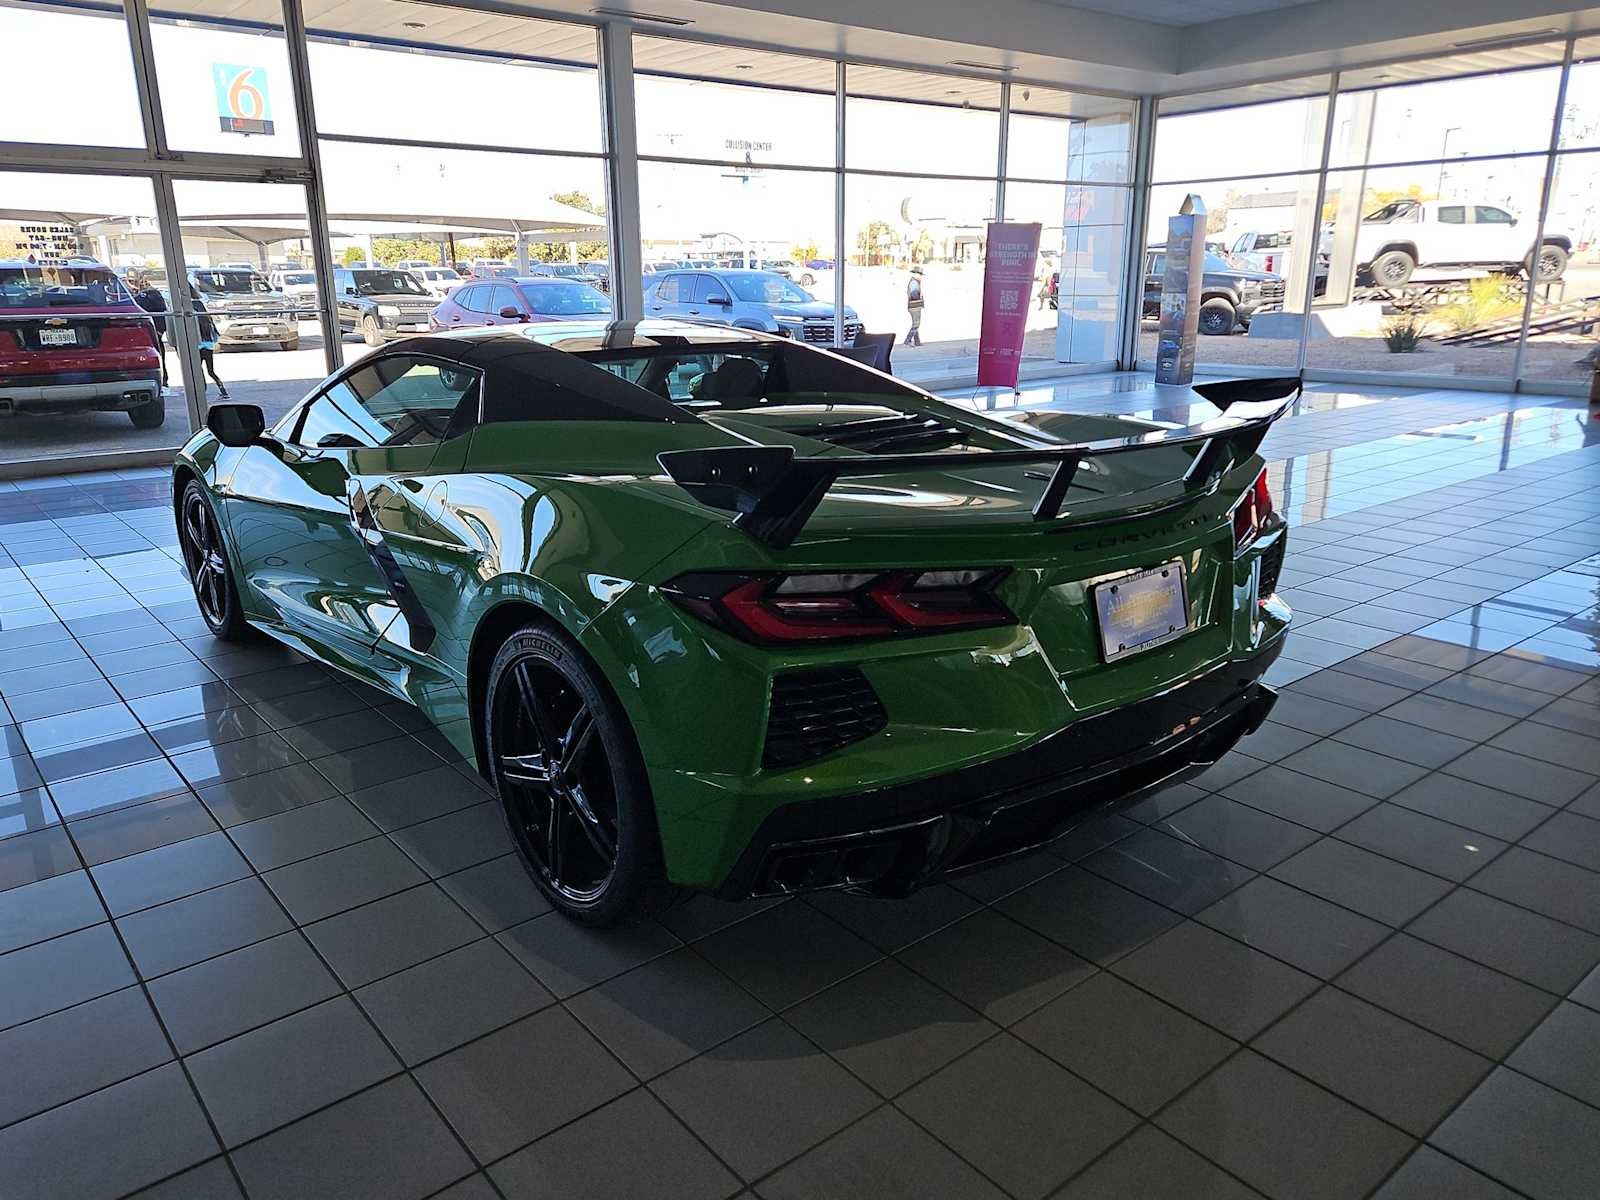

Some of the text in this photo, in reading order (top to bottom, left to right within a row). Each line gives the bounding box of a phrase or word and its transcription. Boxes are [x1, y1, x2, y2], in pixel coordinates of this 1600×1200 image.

[228, 68, 264, 120] 6
[725, 138, 773, 152] COLLISION CENTER
[1074, 513, 1212, 551] CORVETTE
[522, 638, 561, 658] MICHELIN
